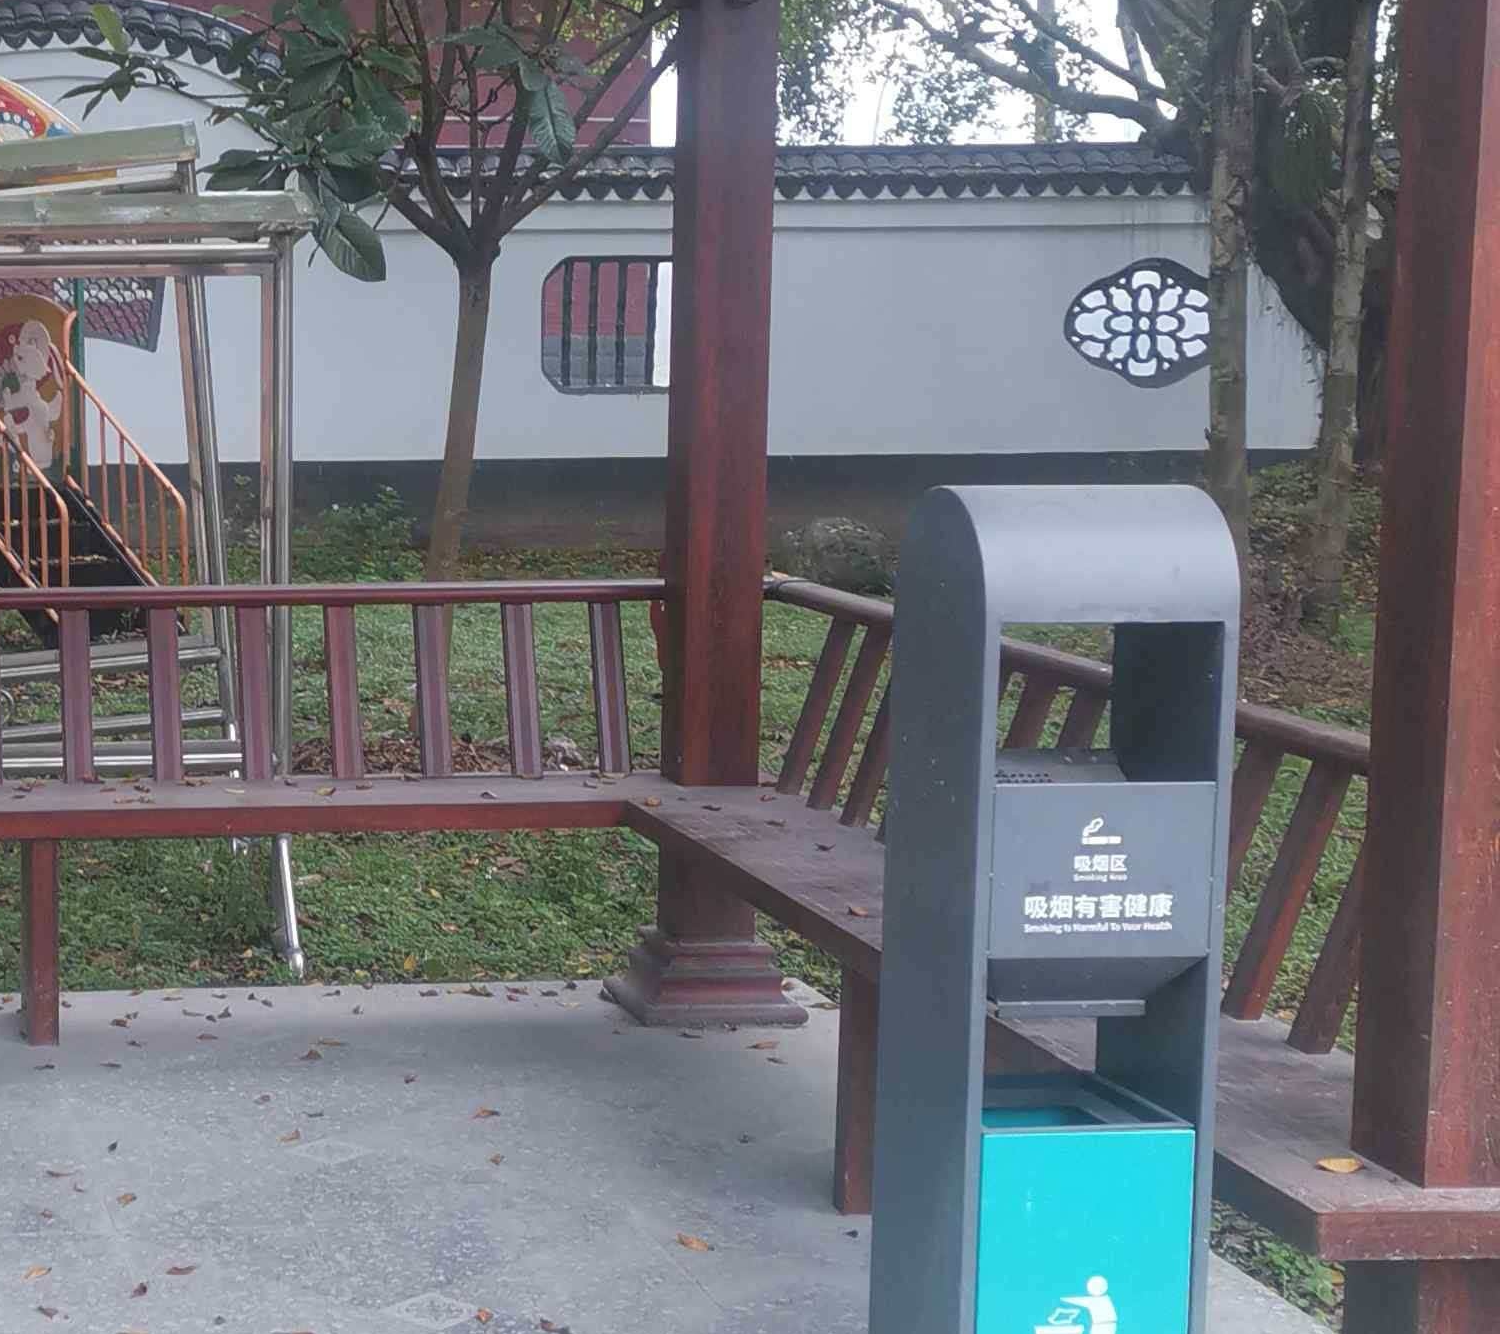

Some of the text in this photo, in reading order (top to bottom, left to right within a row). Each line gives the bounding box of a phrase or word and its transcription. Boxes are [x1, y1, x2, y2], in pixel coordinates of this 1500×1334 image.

[1073, 854, 1128, 873] 吸烟区
[1024, 893, 1174, 919] 吸烟有害健康
